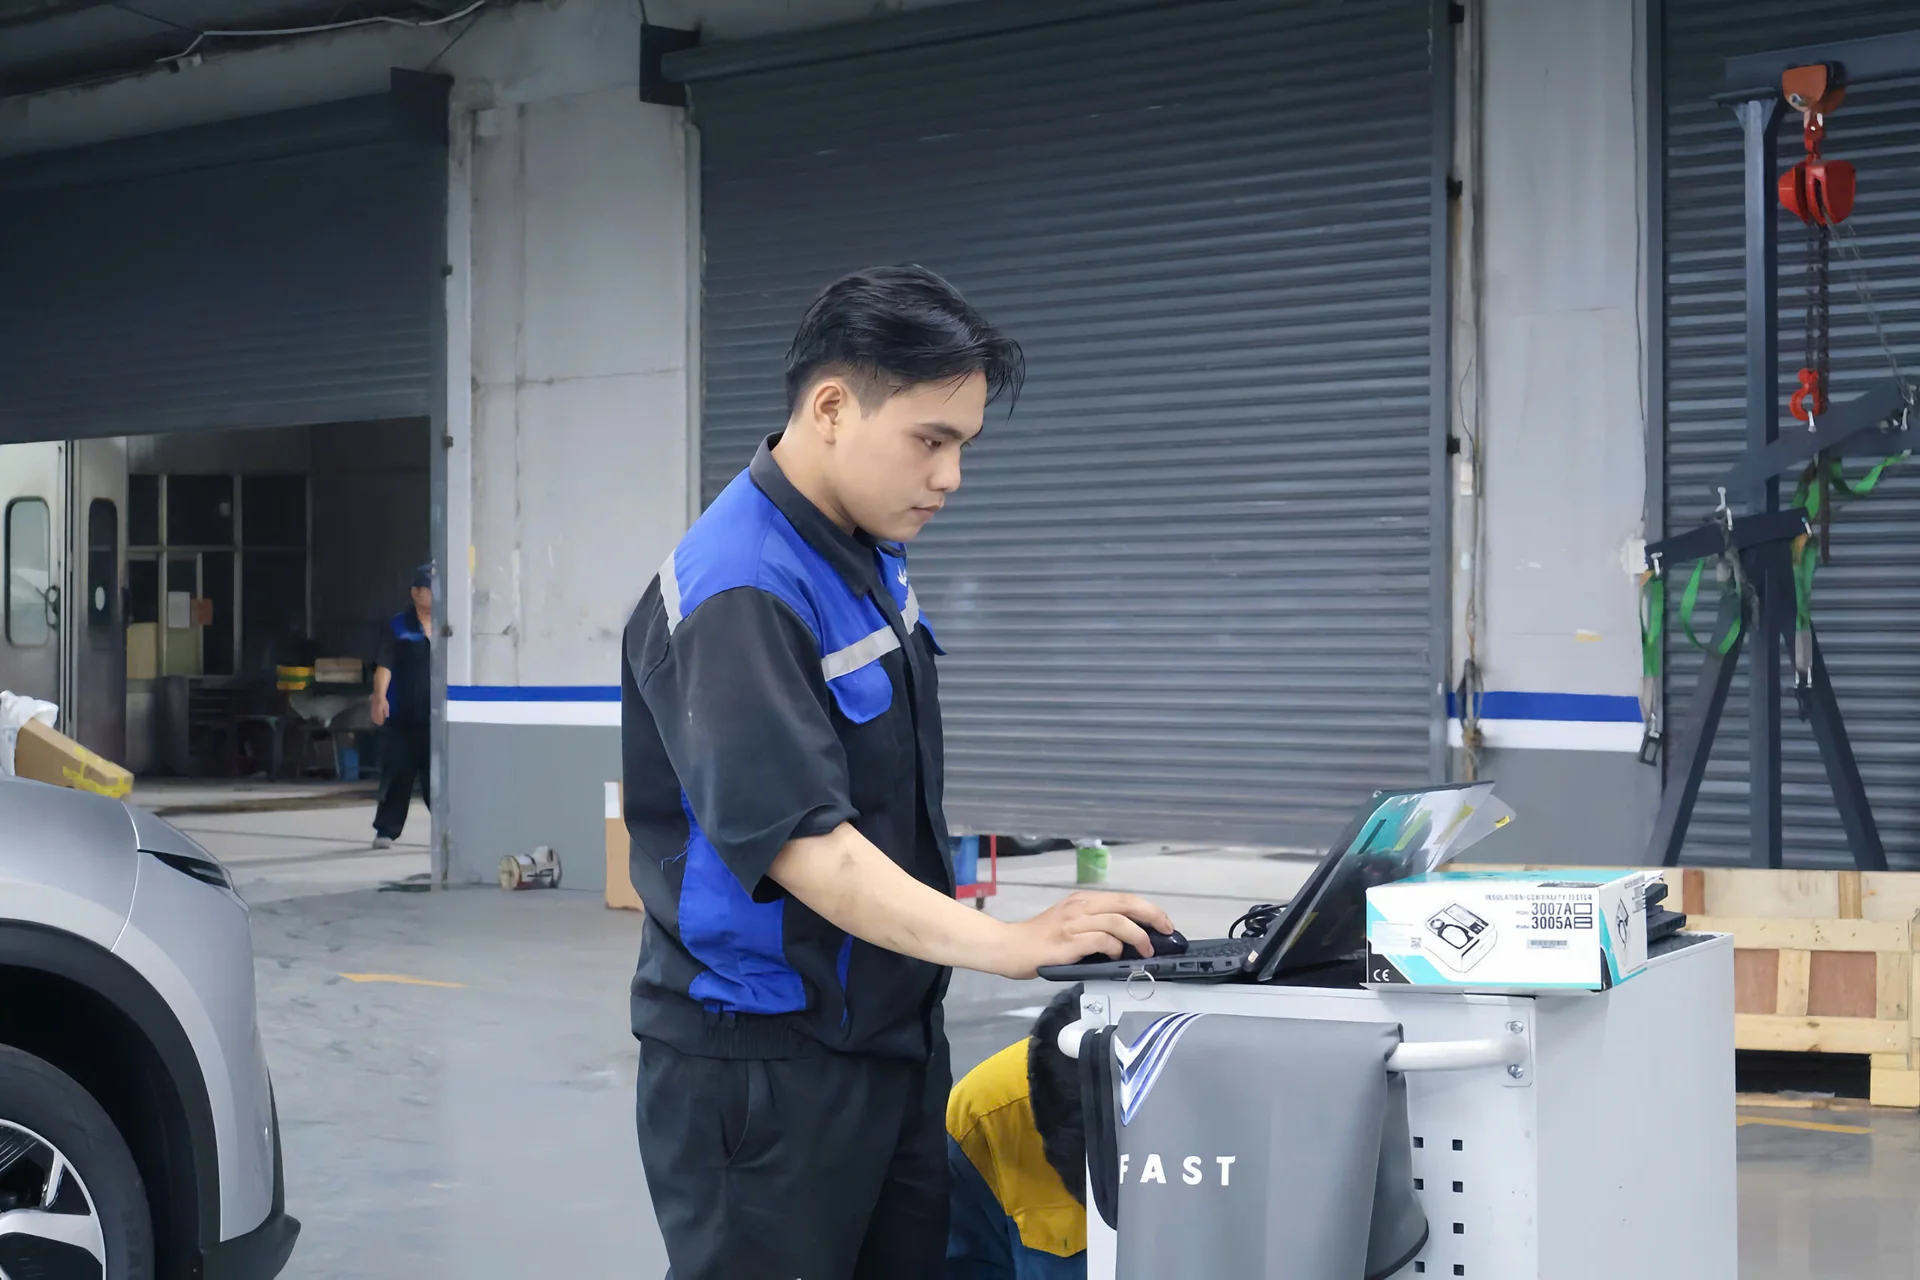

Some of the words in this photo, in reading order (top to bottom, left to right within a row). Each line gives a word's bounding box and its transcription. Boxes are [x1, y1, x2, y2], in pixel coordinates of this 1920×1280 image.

[1531, 902, 1573, 916] 3007A
[1531, 916, 1573, 930] 3005A
[1373, 969, 1390, 982] CE
[1119, 1153, 1237, 1186] FAST
